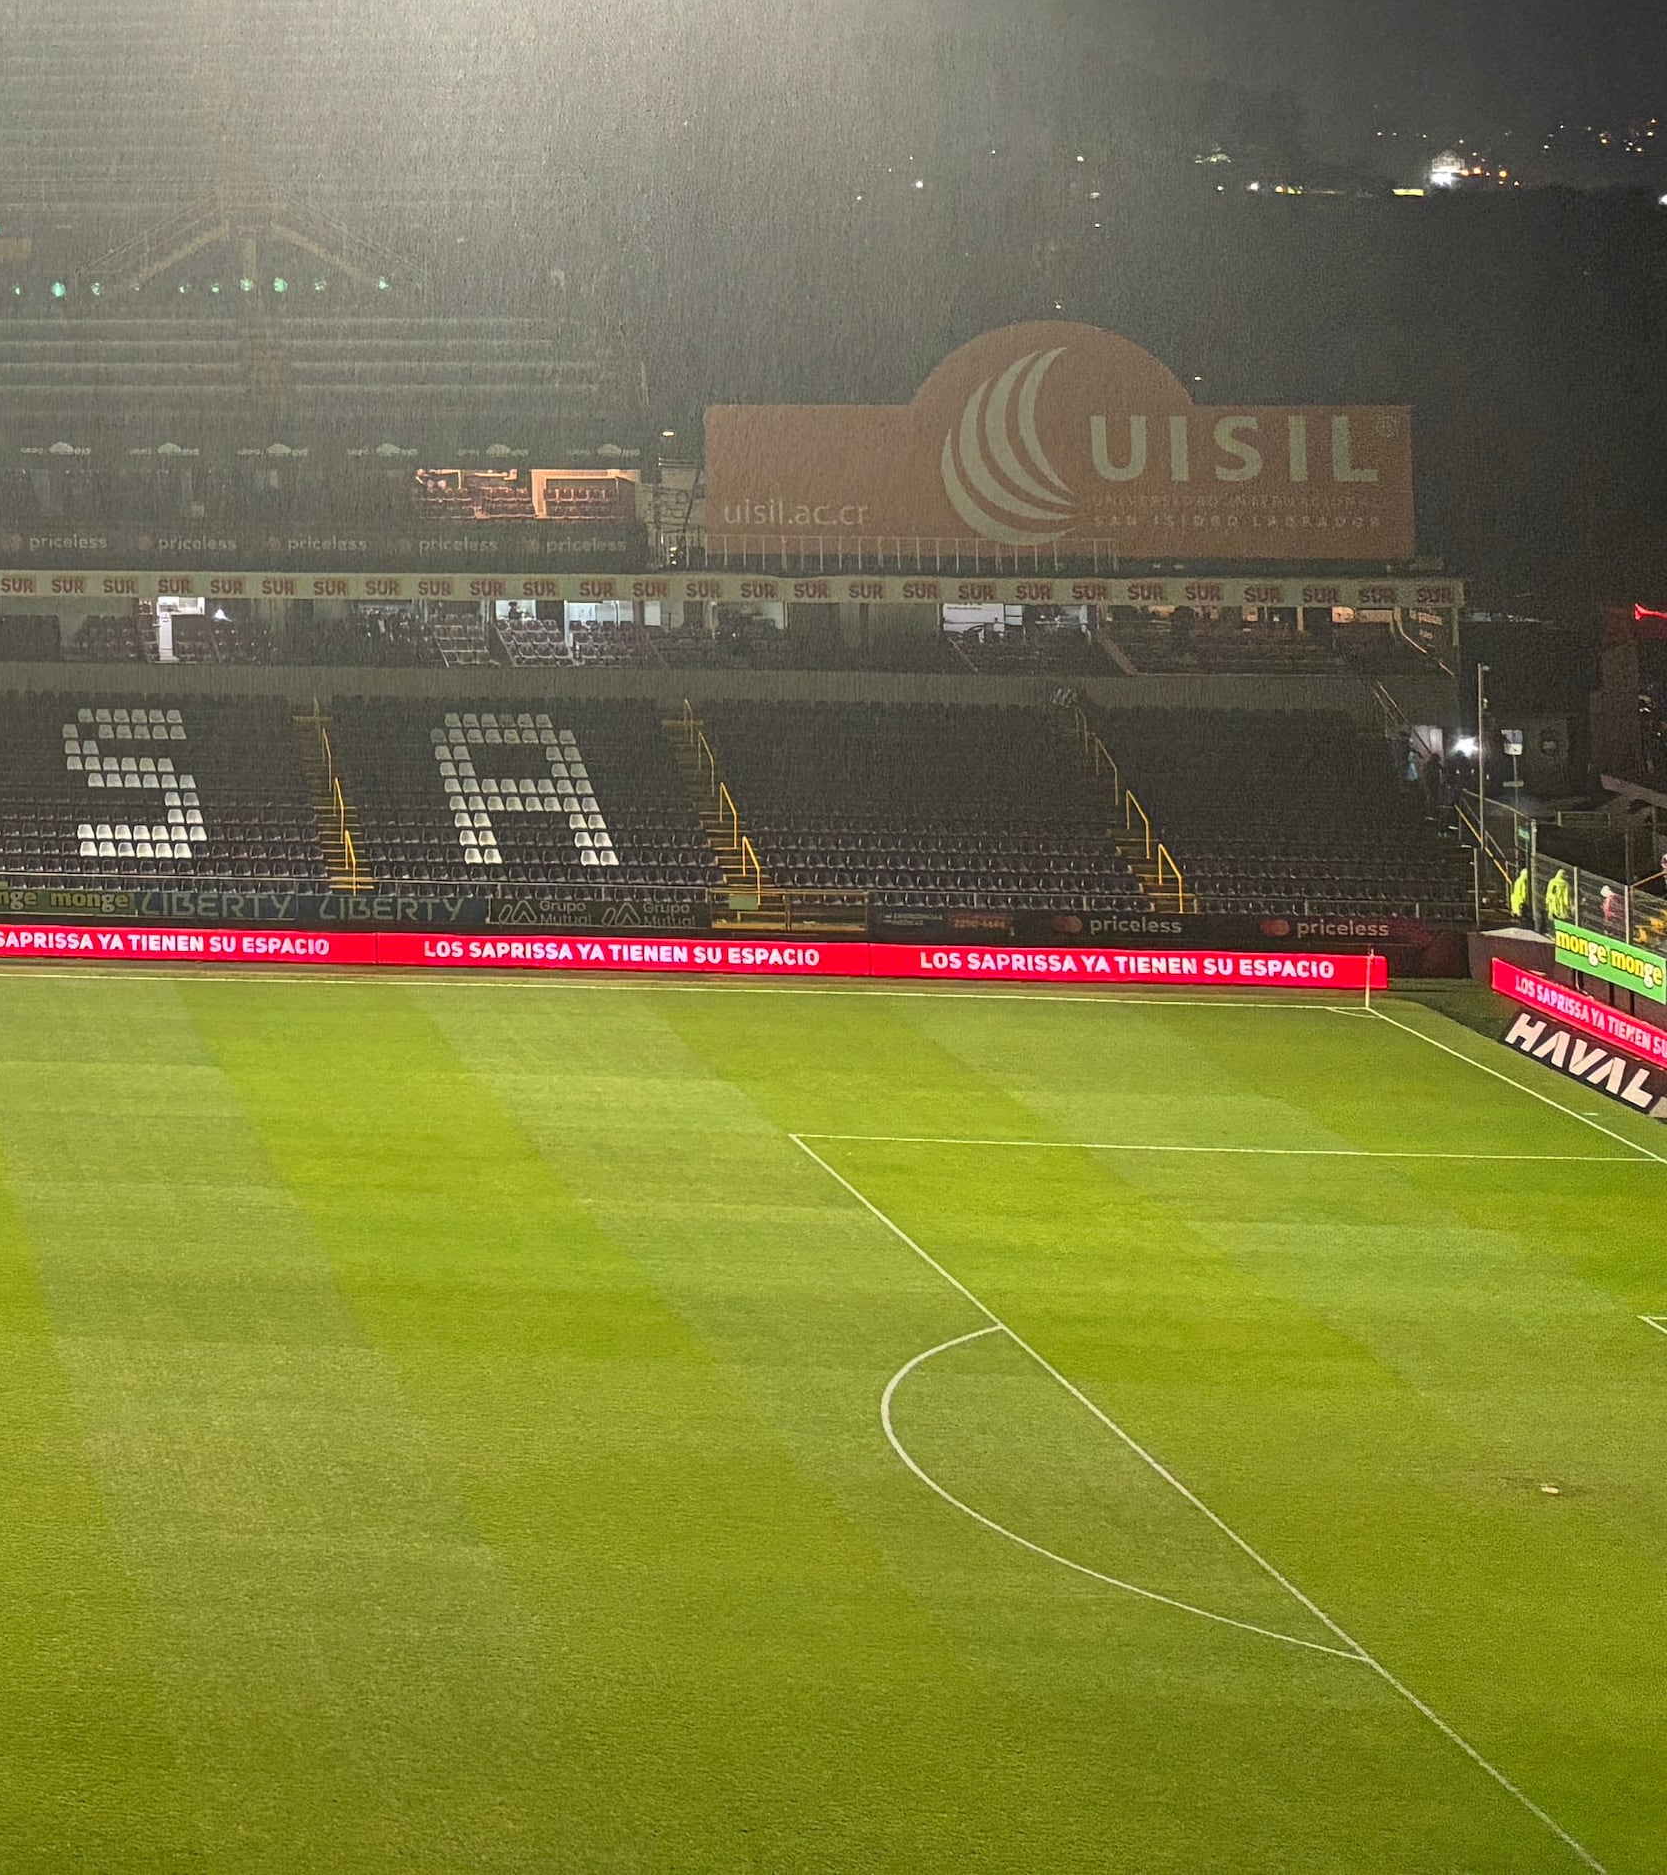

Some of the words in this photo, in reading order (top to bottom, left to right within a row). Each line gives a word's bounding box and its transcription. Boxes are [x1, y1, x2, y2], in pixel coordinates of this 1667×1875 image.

[1089, 414, 1380, 483] UISIL
[723, 497, 868, 525] uisil.ac.cr
[29, 533, 107, 552] priceless
[157, 576, 193, 595] SUR
[418, 579, 453, 597] SUR
[50, 890, 130, 913] monge
[140, 891, 294, 918] LIBERTY
[318, 896, 466, 922] LIBERTY
[539, 899, 587, 914] Grupo
[642, 901, 691, 916] Grupo
[1089, 915, 1183, 937] priceless
[1296, 917, 1390, 939] priceless
[97, 933, 124, 950] YA
[127, 934, 204, 952] TIENEN
[209, 936, 236, 953] SU
[242, 937, 330, 955] ESPACIO
[424, 941, 464, 958] LOS
[469, 941, 573, 960] SAPRISSA
[576, 943, 605, 961] YA
[608, 944, 688, 963] TIENEN
[693, 946, 722, 964] SU
[728, 947, 820, 966] ESPACIO
[1554, 929, 1608, 967] monge
[920, 952, 962, 969] LOS
[967, 952, 1077, 972] SAPRISSA
[1080, 955, 1110, 973] YA
[1114, 956, 1197, 974] TIENEN
[1203, 957, 1233, 976] SU
[1239, 959, 1334, 978] ESPACIO
[1609, 948, 1664, 989] monge
[1514, 974, 1537, 999] LOS
[1536, 983, 1590, 1024] SAPRISSA
[1590, 1005, 1607, 1032] YA
[1606, 1014, 1652, 1053] TIENEN
[1504, 1012, 1654, 1109] HAVAL
